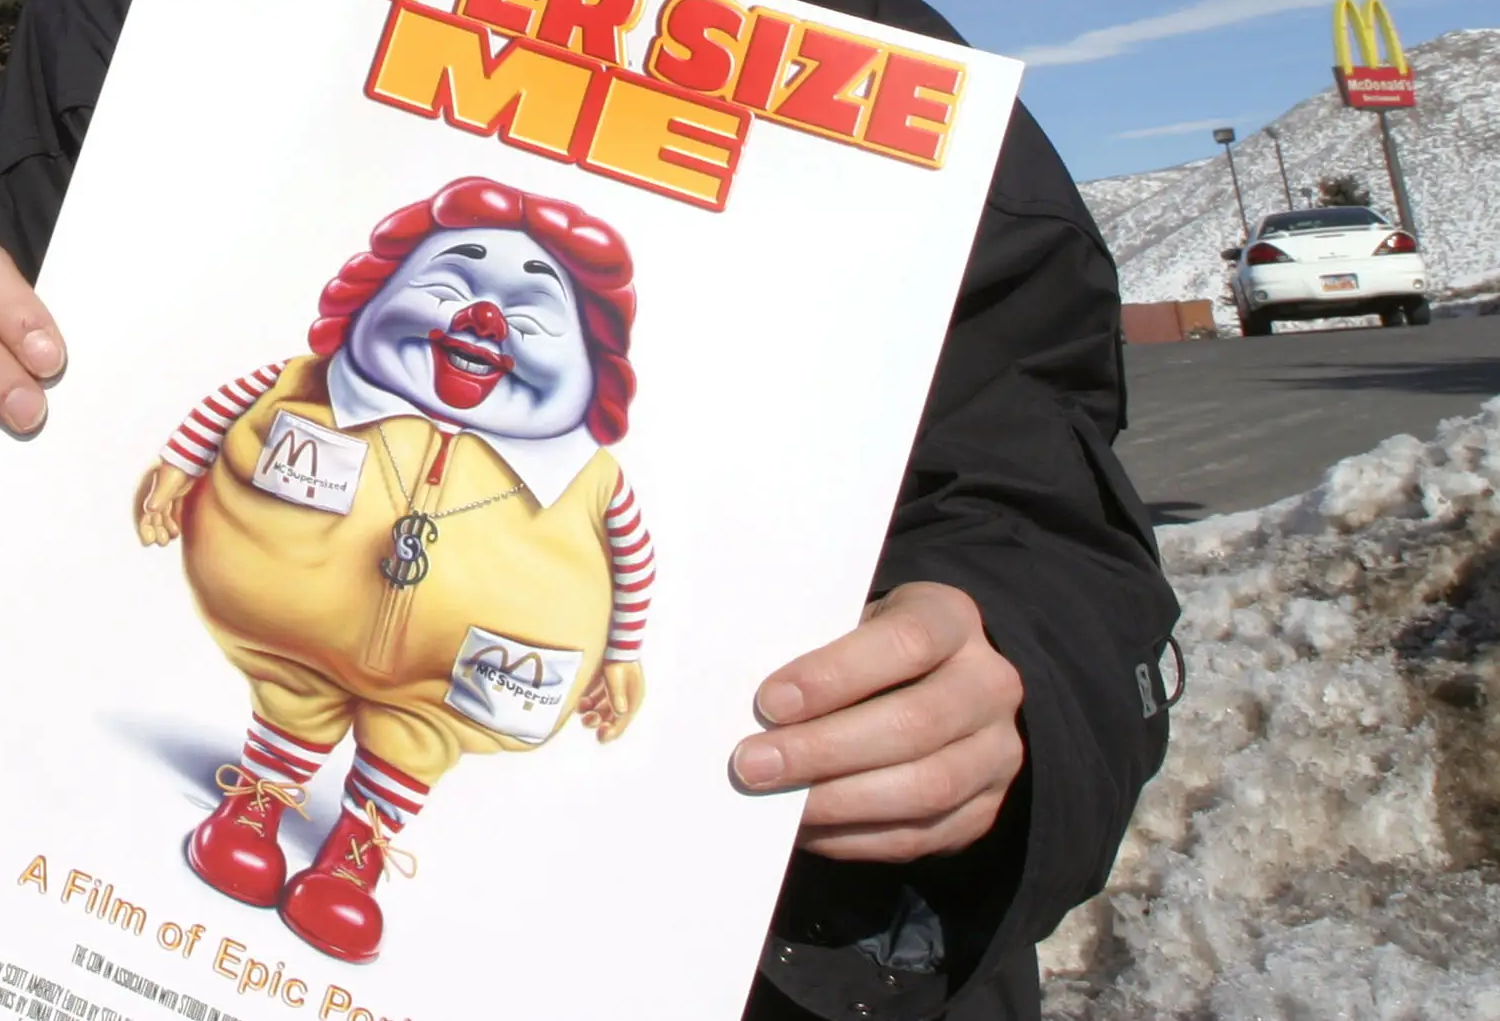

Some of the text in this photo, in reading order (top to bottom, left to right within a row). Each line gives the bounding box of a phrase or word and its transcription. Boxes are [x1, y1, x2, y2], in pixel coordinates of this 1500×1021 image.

[16, 854, 48, 894] A
[60, 869, 148, 937] Film
[156, 921, 206, 960] of
[212, 936, 309, 1010] Epic
[71, 943, 89, 968] THE
[2, 963, 29, 990] SCOTT
